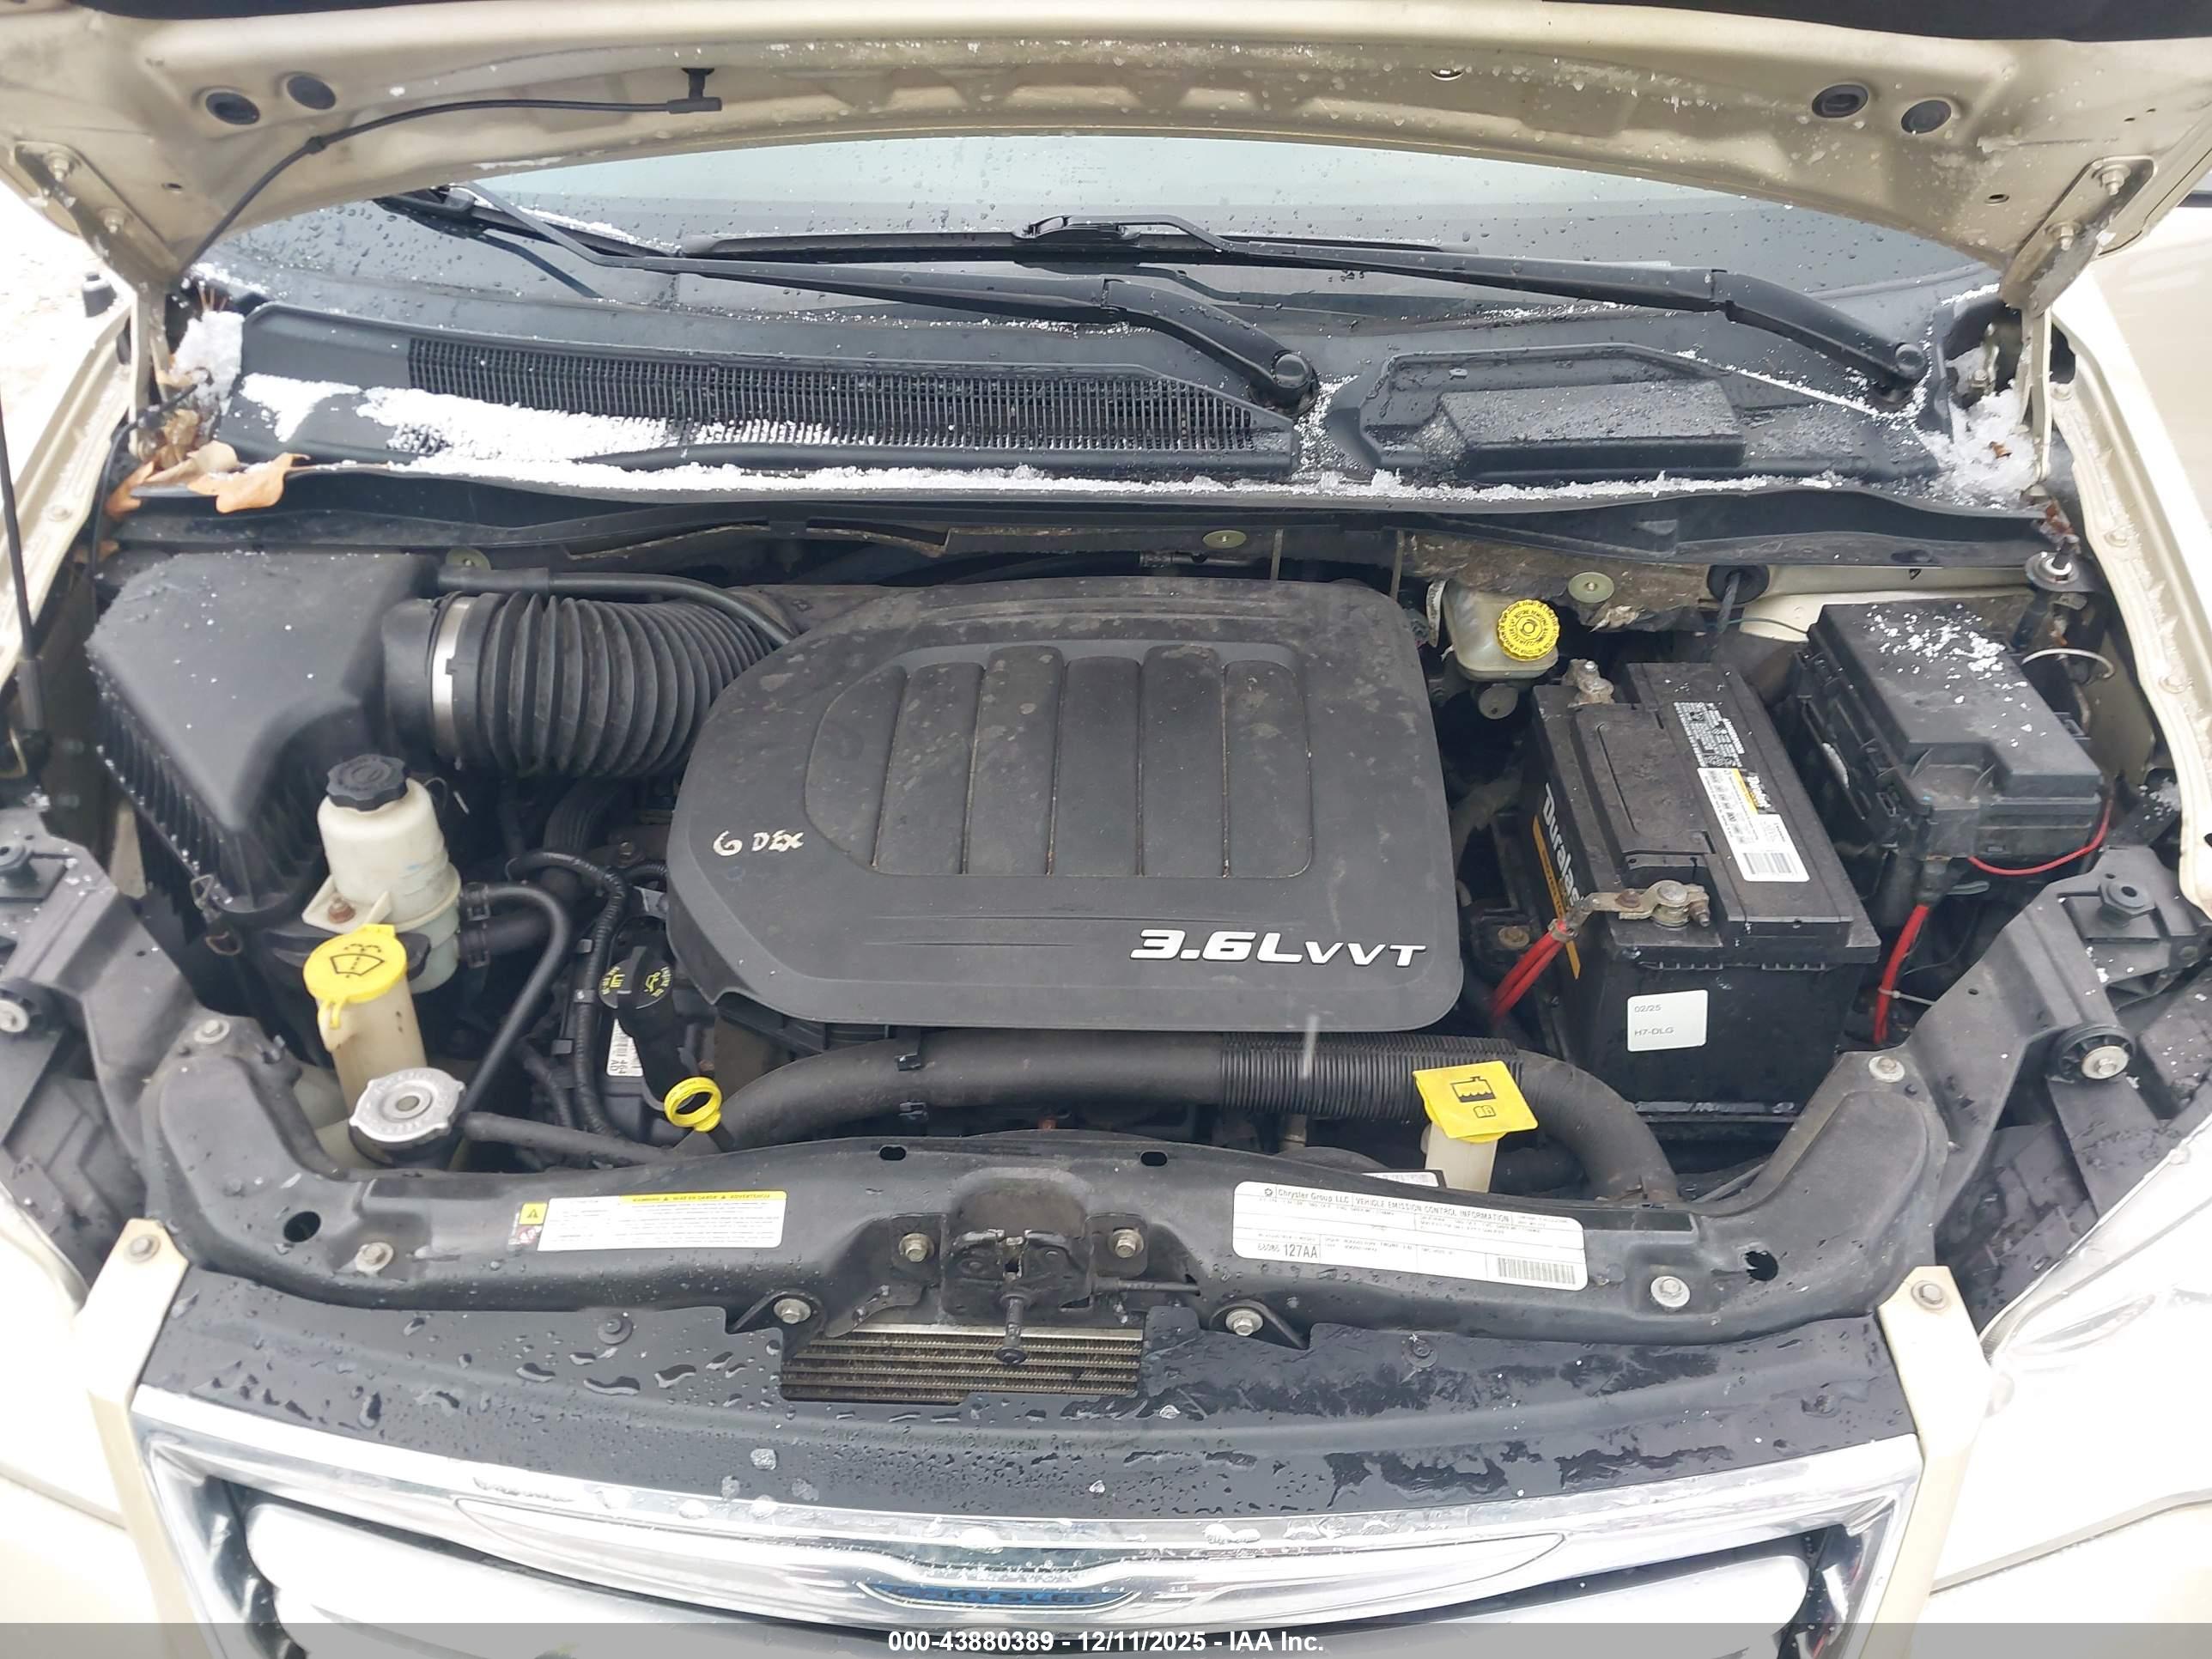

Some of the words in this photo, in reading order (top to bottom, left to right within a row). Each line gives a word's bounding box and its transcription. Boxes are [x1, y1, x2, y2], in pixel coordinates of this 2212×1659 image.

[713, 830, 743, 857] 6
[1542, 782, 1585, 908] Duralas
[1129, 928, 1303, 963] 3.6L
[1634, 1003, 1662, 1012] 02/25
[1278, 1188, 1309, 1200] Chrysler
[1310, 1192, 1333, 1203] Group
[1335, 1195, 1350, 1204] LLC
[1355, 1196, 1384, 1208] VEHICLE
[1388, 1200, 1422, 1212] EMISSION
[1424, 1206, 1456, 1217] CONTROL
[1460, 1210, 1510, 1223] INFORMATION
[1284, 1243, 1318, 1259] 127AA
